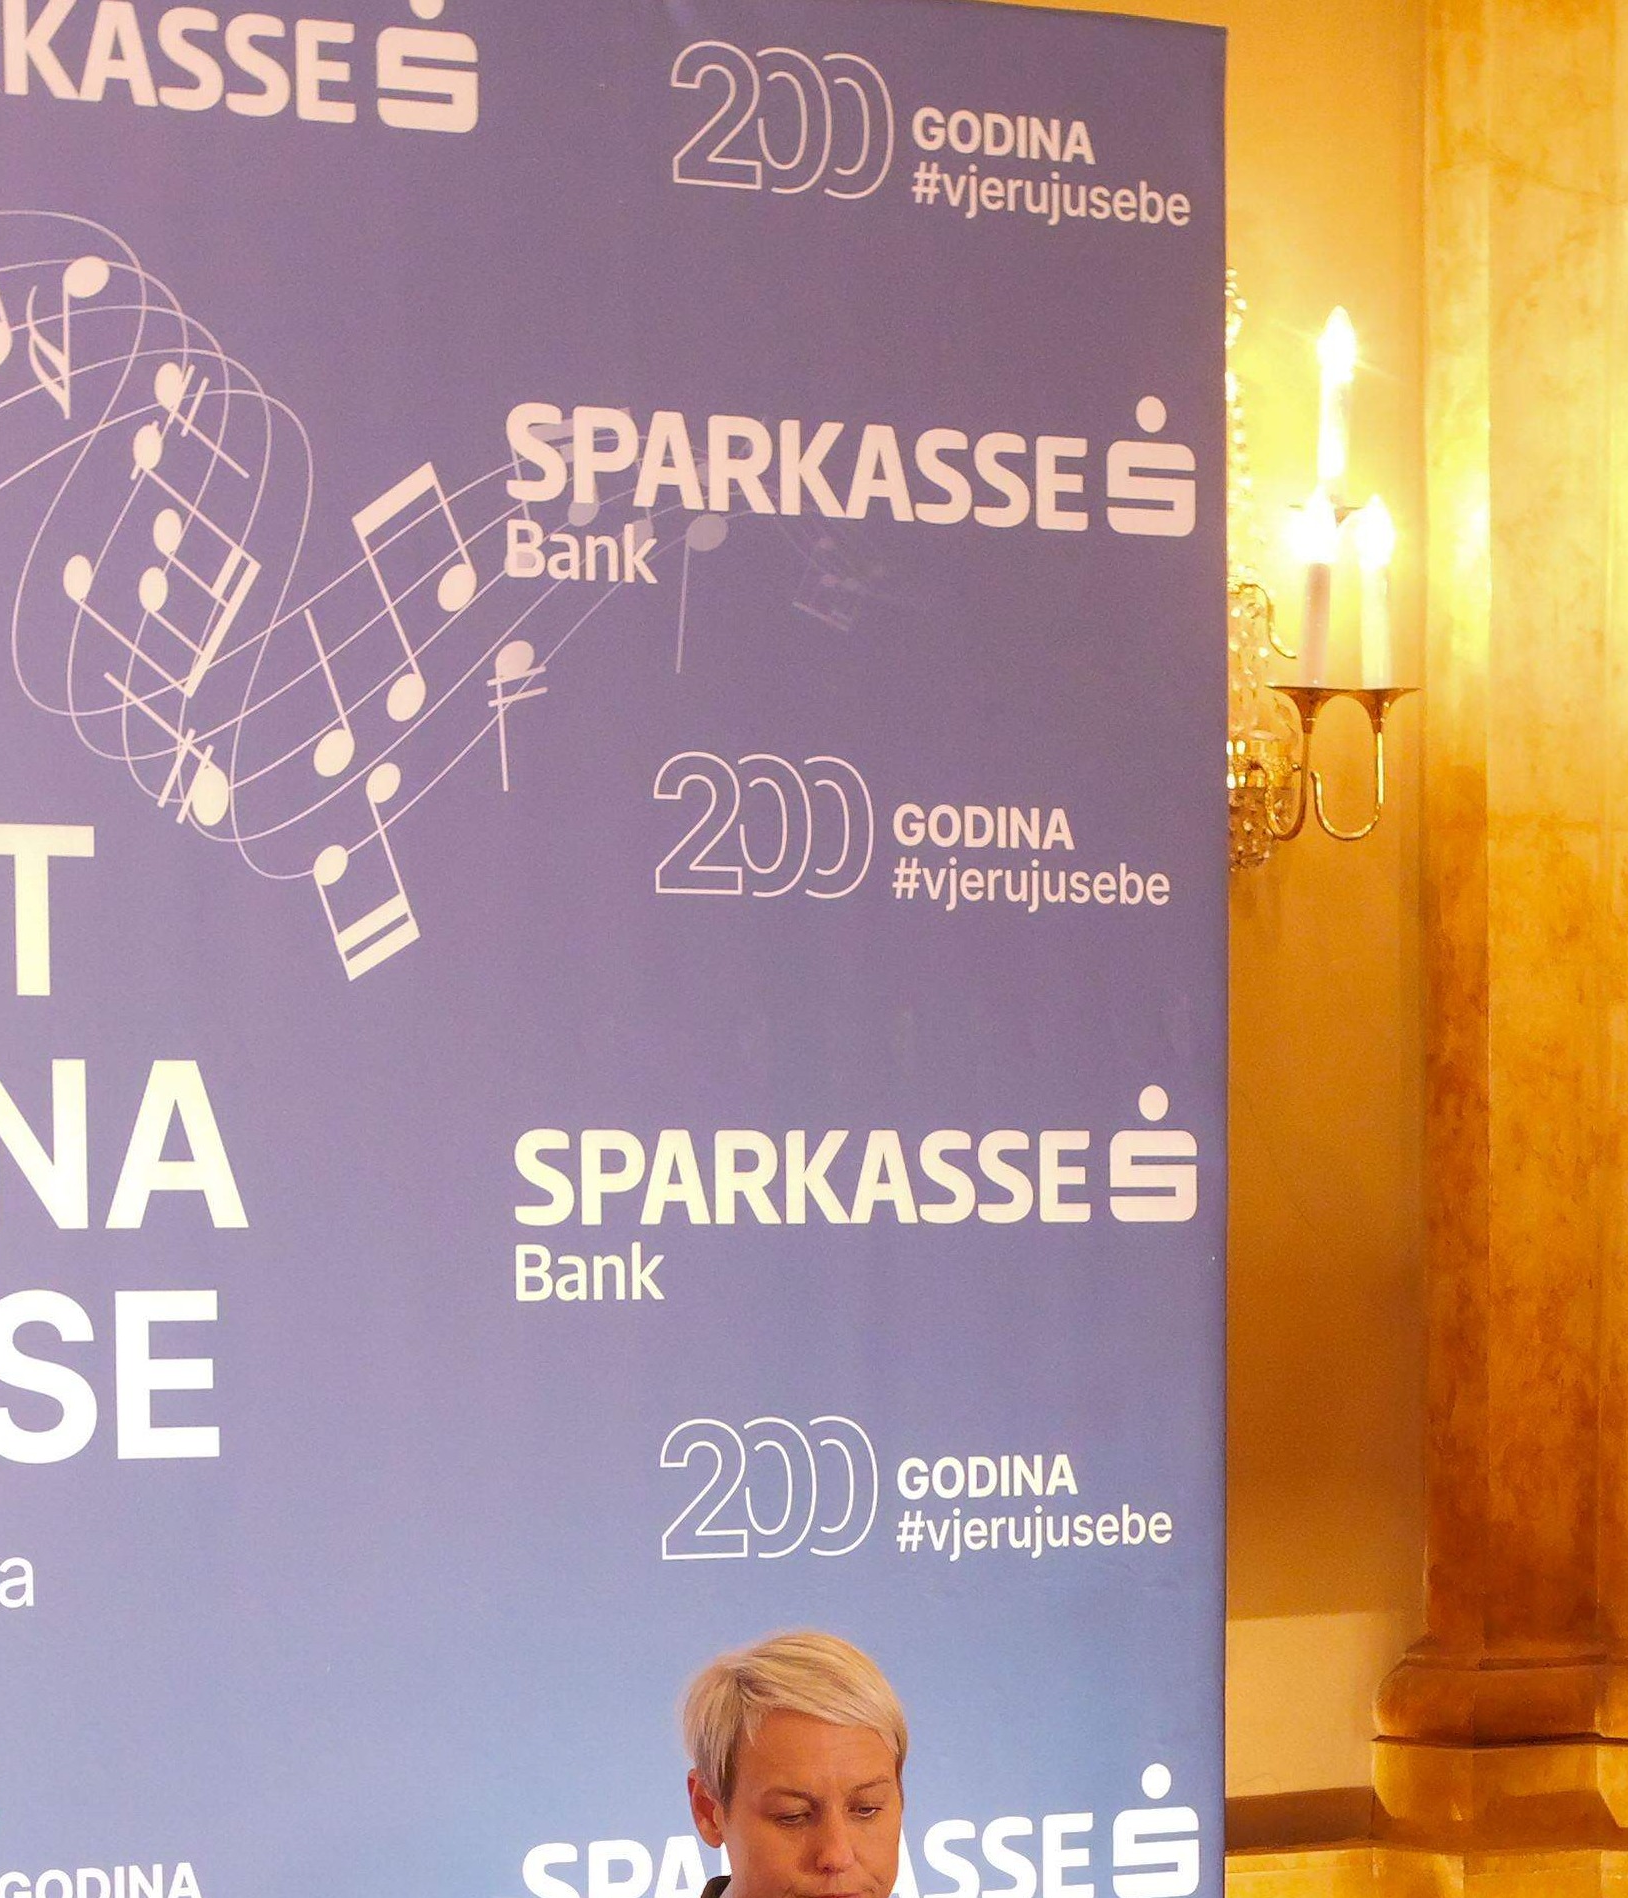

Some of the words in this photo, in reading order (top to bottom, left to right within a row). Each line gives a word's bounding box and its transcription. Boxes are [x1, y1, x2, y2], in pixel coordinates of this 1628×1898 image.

[912, 107, 1096, 166] GODINA
[911, 161, 1191, 226] #vjerujusebe
[505, 402, 1089, 532] SPARKASSE
[505, 519, 658, 584] Bank
[892, 803, 1075, 851] GODINA
[891, 856, 1170, 912] #vjerujusebe
[514, 1128, 1091, 1227] SPARKASSE
[515, 1241, 665, 1302] Bank
[896, 1454, 1079, 1500] GODINA
[896, 1504, 1173, 1562] #vjerujusebe
